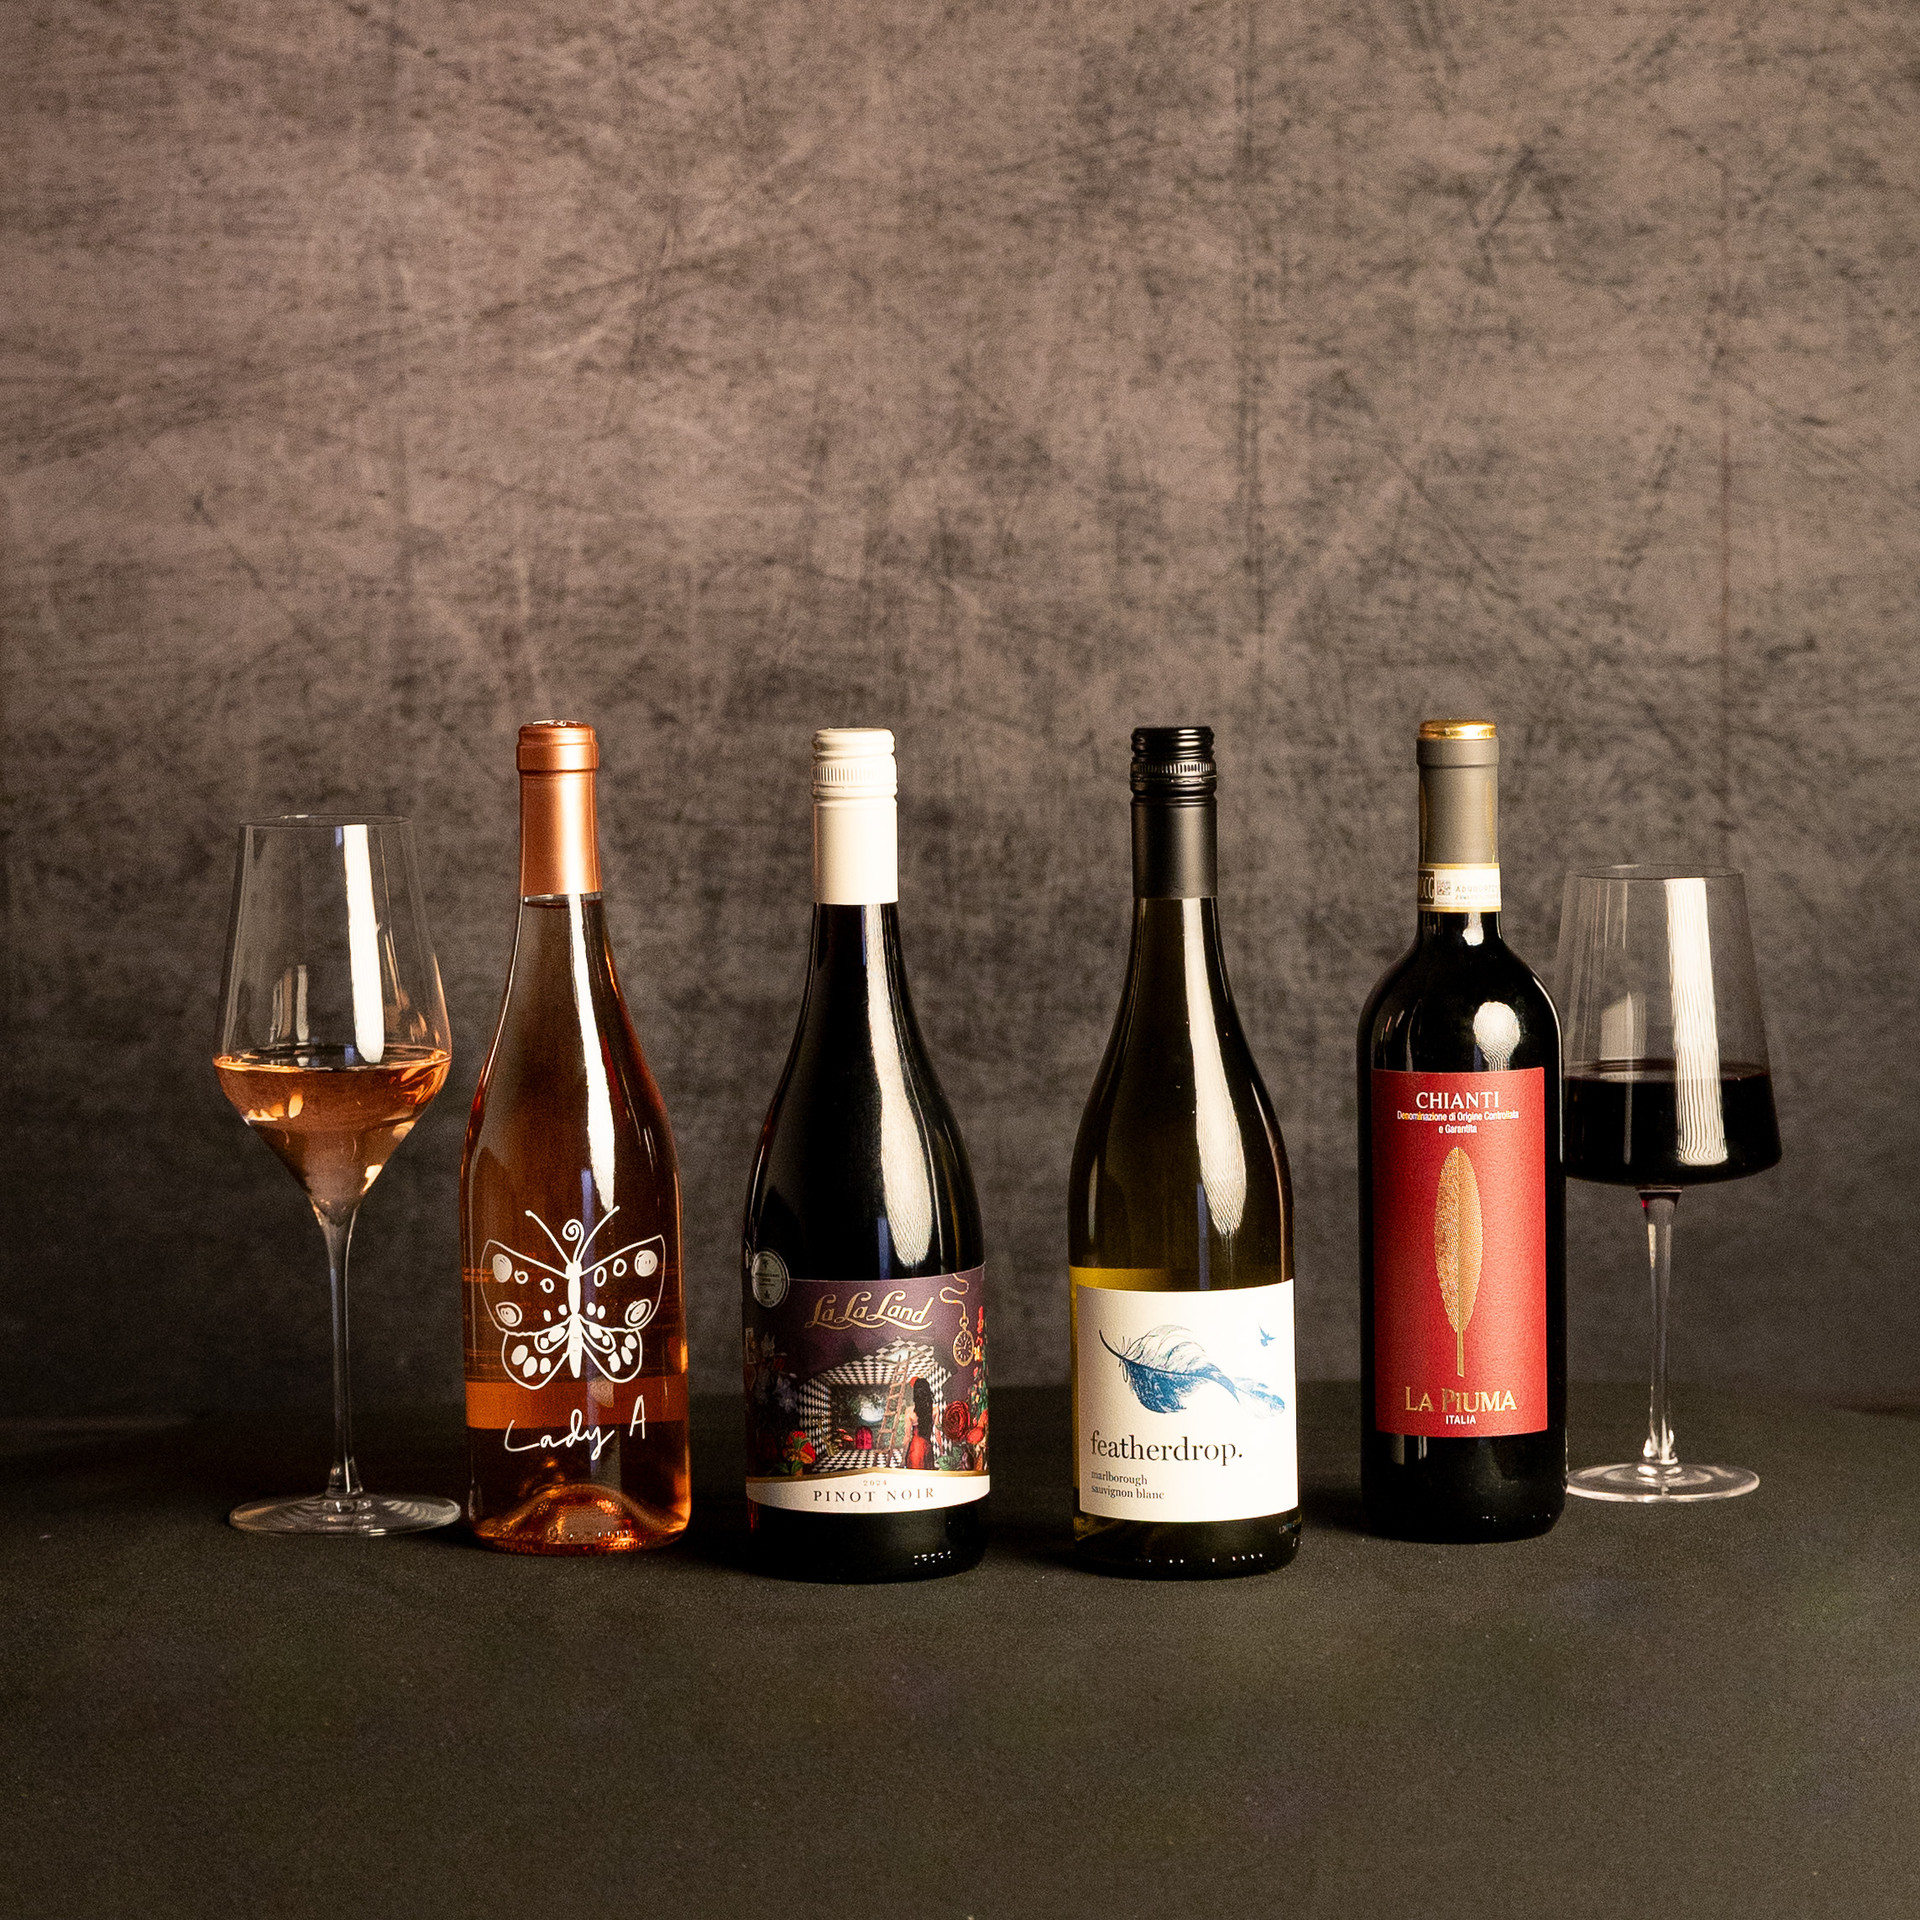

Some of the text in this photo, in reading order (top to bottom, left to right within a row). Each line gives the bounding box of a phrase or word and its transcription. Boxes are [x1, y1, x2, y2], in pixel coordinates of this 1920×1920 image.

[1416, 1091, 1500, 1109] CHIANTI
[1397, 1110, 1519, 1123] Denominazione di Origine Controllata
[1438, 1124, 1478, 1134] e Garantita
[804, 1290, 934, 1331] La La Land
[504, 1394, 647, 1461] Lady A
[1445, 1414, 1477, 1425] ITALIA
[1090, 1430, 1244, 1467] featherdrop.
[1091, 1470, 1148, 1486] marlborough
[813, 1487, 936, 1504] PINOT NOIR
[1091, 1484, 1165, 1501] sauvignon blanc
